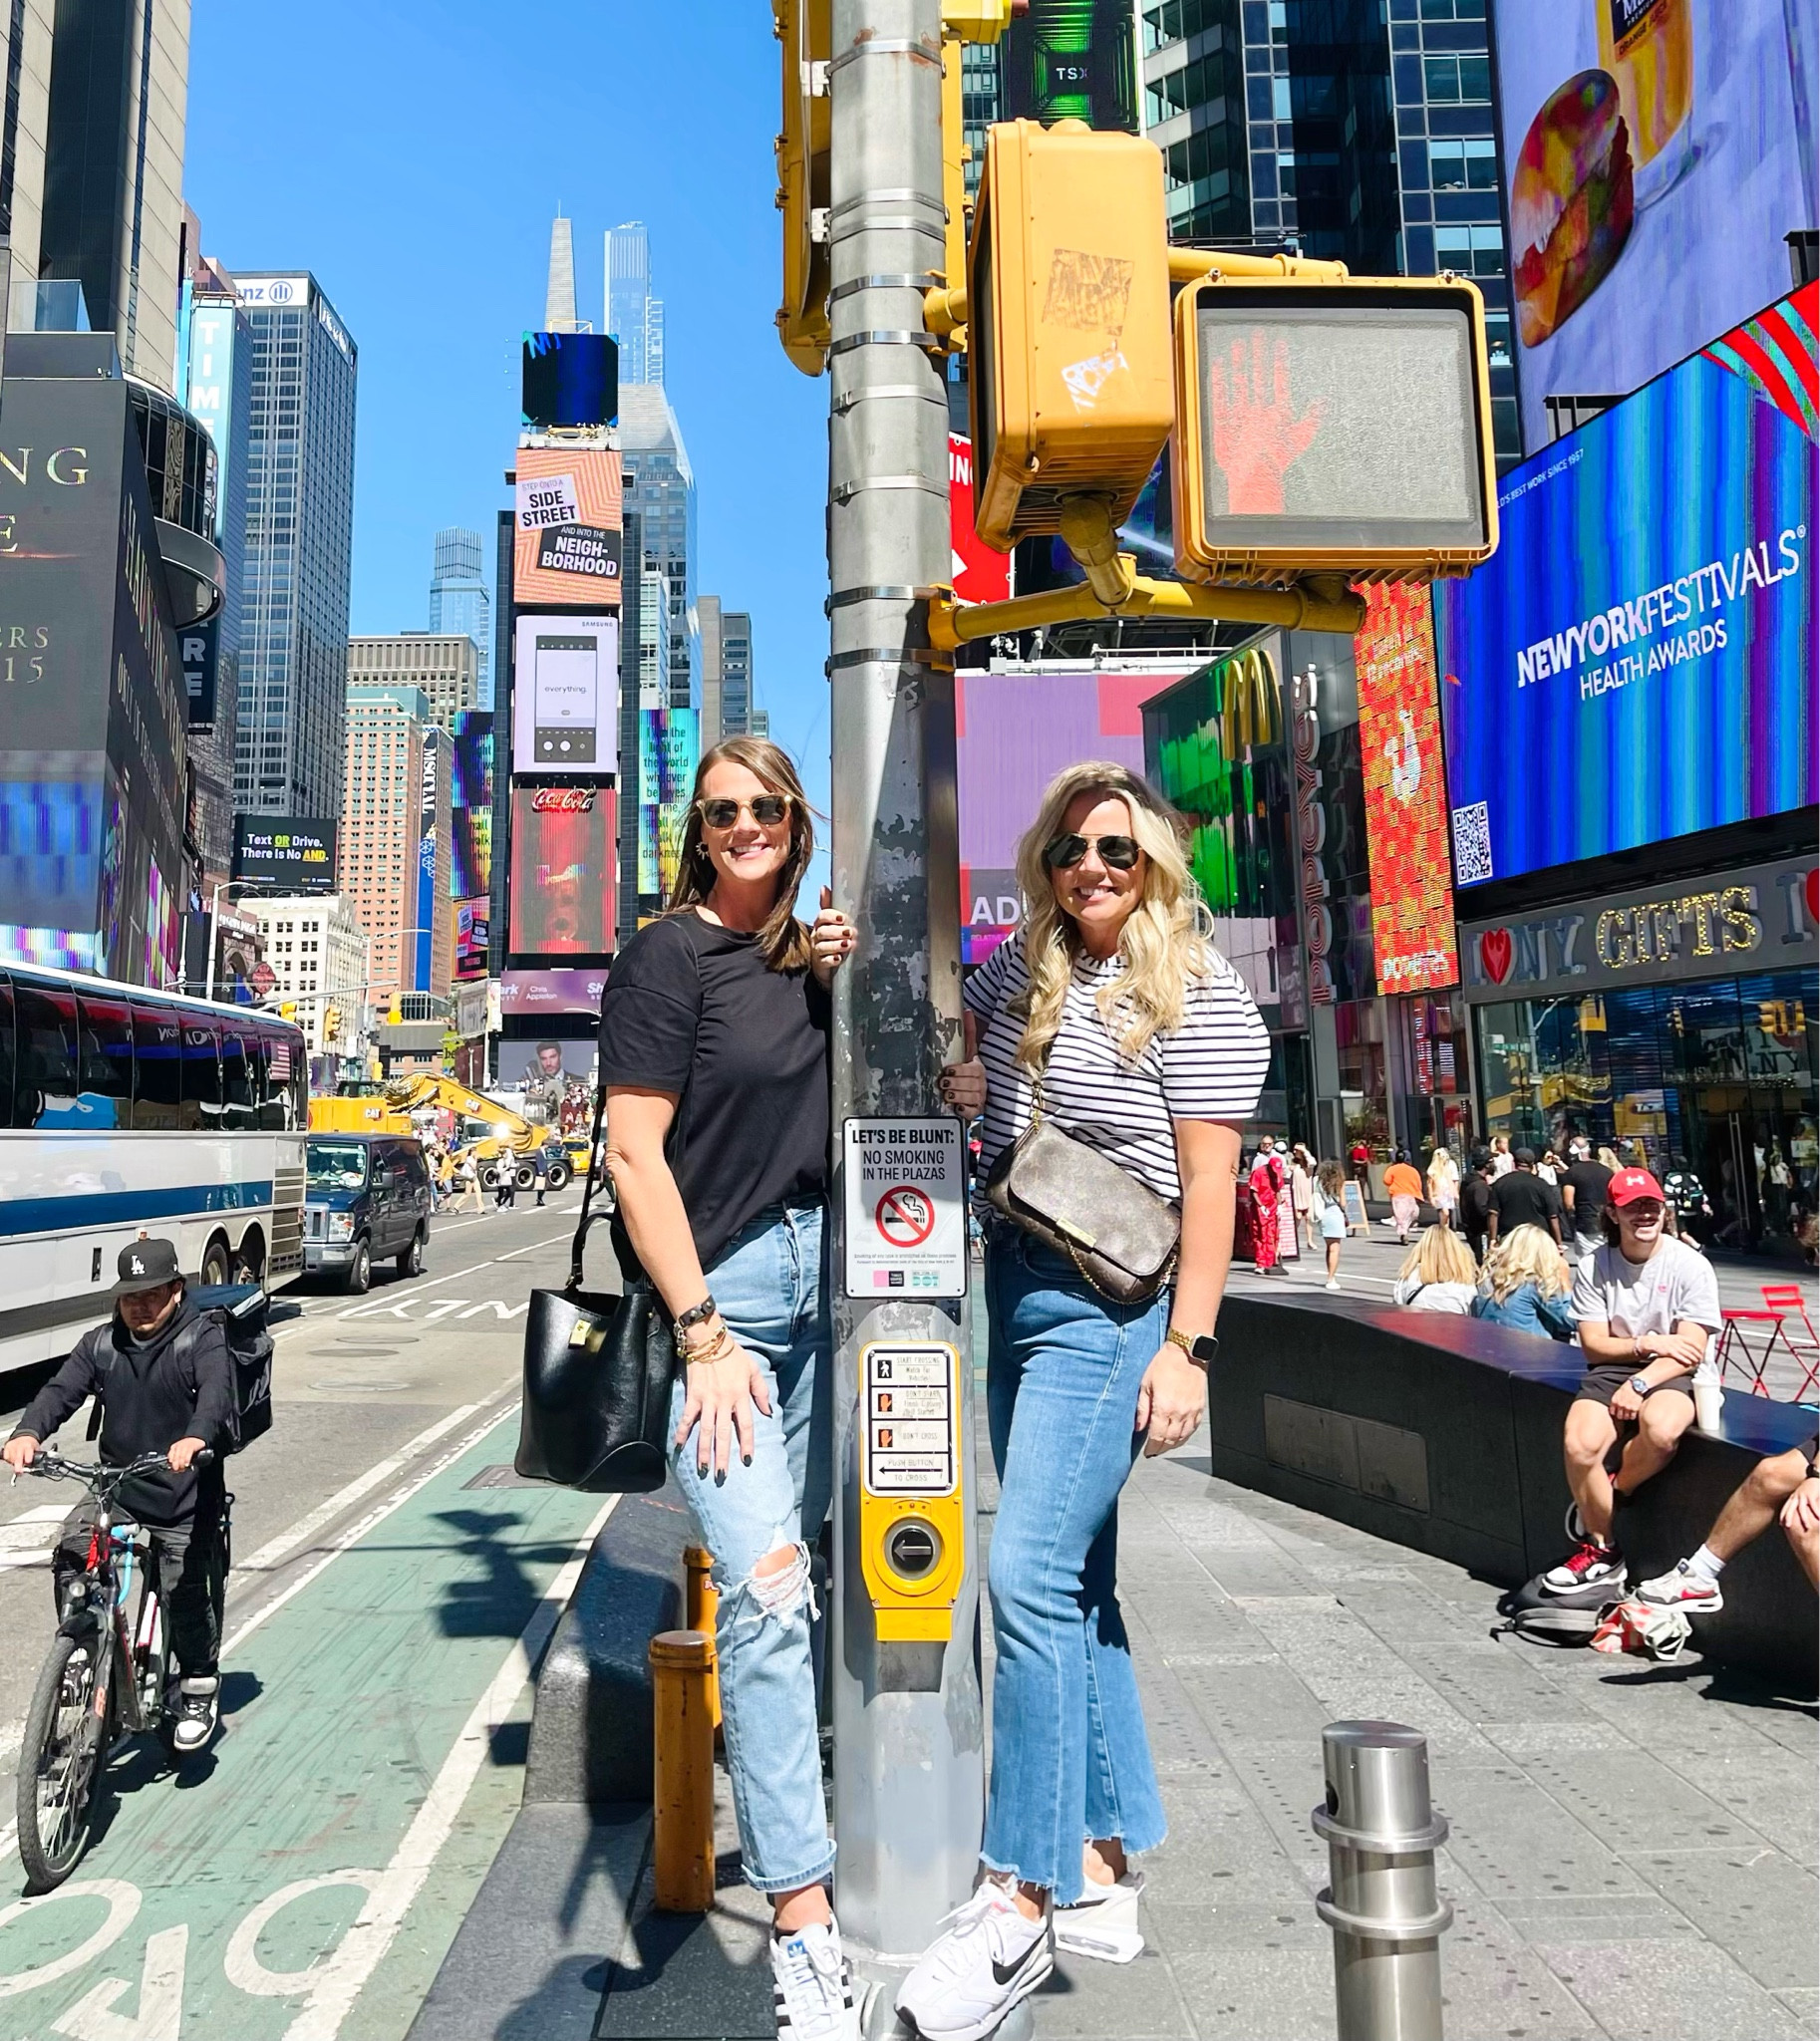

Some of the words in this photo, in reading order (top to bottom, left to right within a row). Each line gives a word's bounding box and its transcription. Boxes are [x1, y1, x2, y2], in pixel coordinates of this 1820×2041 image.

[950, 452, 974, 486] IN
[1511, 483, 1527, 499] BEST
[1527, 470, 1547, 489] WORK
[1547, 458, 1568, 478] SINCE
[529, 490, 564, 508] SIDE
[522, 505, 575, 527] STREET
[561, 526, 576, 535] AND
[577, 528, 592, 538] INTO
[593, 529, 607, 539] THE
[555, 536, 609, 558] NEIGH-
[541, 551, 617, 576] BORHOOD
[0, 627, 48, 649] RS
[183, 624, 207, 697] RE
[1580, 649, 1646, 702] HEALTH
[1647, 619, 1728, 676] AWARDS
[5, 657, 43, 684] 15
[544, 686, 587, 695] everything.
[671, 727, 686, 737] the
[674, 741, 684, 753] of
[672, 819, 686, 828] no
[247, 833, 272, 845] Text
[274, 835, 290, 847] OR
[292, 836, 323, 847] Drive.
[241, 847, 272, 858] There
[287, 849, 301, 859] No
[1514, 916, 1587, 982] NY
[1596, 886, 1760, 968] GIFTS
[852, 1129, 885, 1144] LET'S
[889, 1129, 906, 1144] BE
[909, 1129, 955, 1144] BLUNT:
[863, 1150, 881, 1165] NO
[885, 1150, 944, 1165] SMOKING
[863, 1167, 874, 1180] IN
[878, 1167, 900, 1180] THE
[902, 1167, 946, 1180] PLAZAS
[131, 1255, 146, 1276] LA
